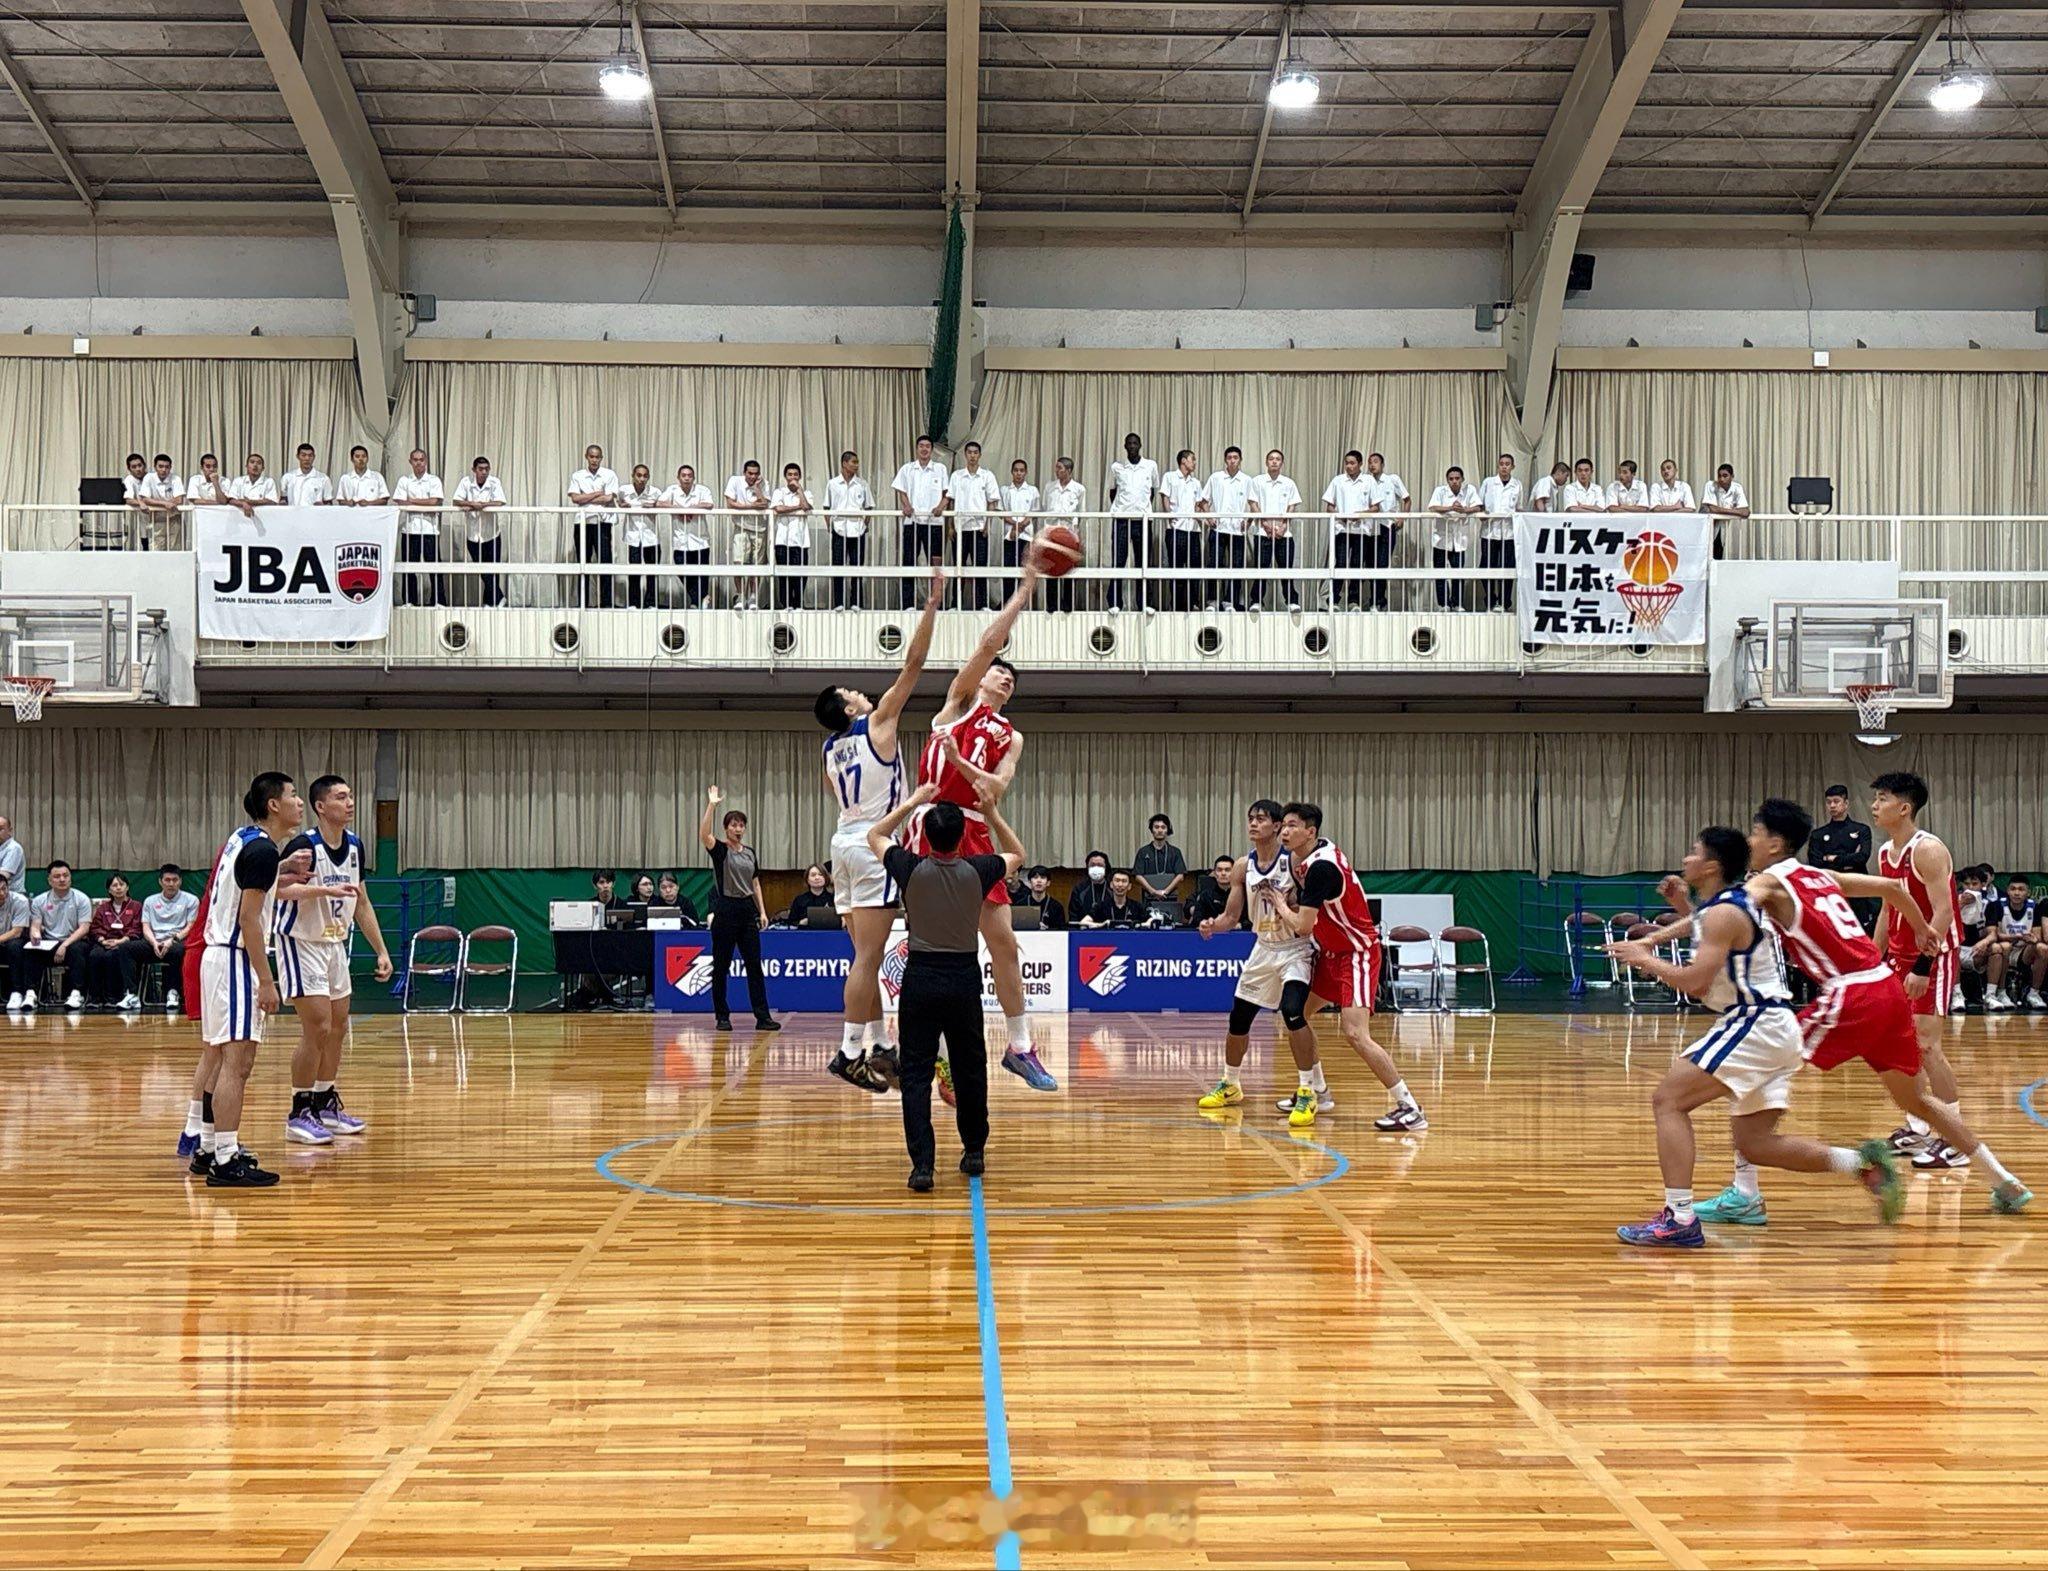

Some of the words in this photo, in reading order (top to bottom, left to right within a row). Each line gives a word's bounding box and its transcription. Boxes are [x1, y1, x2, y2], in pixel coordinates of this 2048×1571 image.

[338, 546, 379, 561] JAPAN
[213, 545, 331, 593] JBA
[338, 560, 378, 570] BASKETBALL
[1535, 563, 1615, 592] 日本を
[237, 597, 282, 605] BASKETBALL
[838, 763, 862, 809] 17
[330, 900, 344, 918] 12
[1813, 893, 1866, 940] 19
[784, 959, 850, 977] ZEPHYR
[1021, 962, 1052, 979] CUP
[1136, 959, 1193, 977] RIZING
[1195, 959, 1248, 977] ZEPHY
